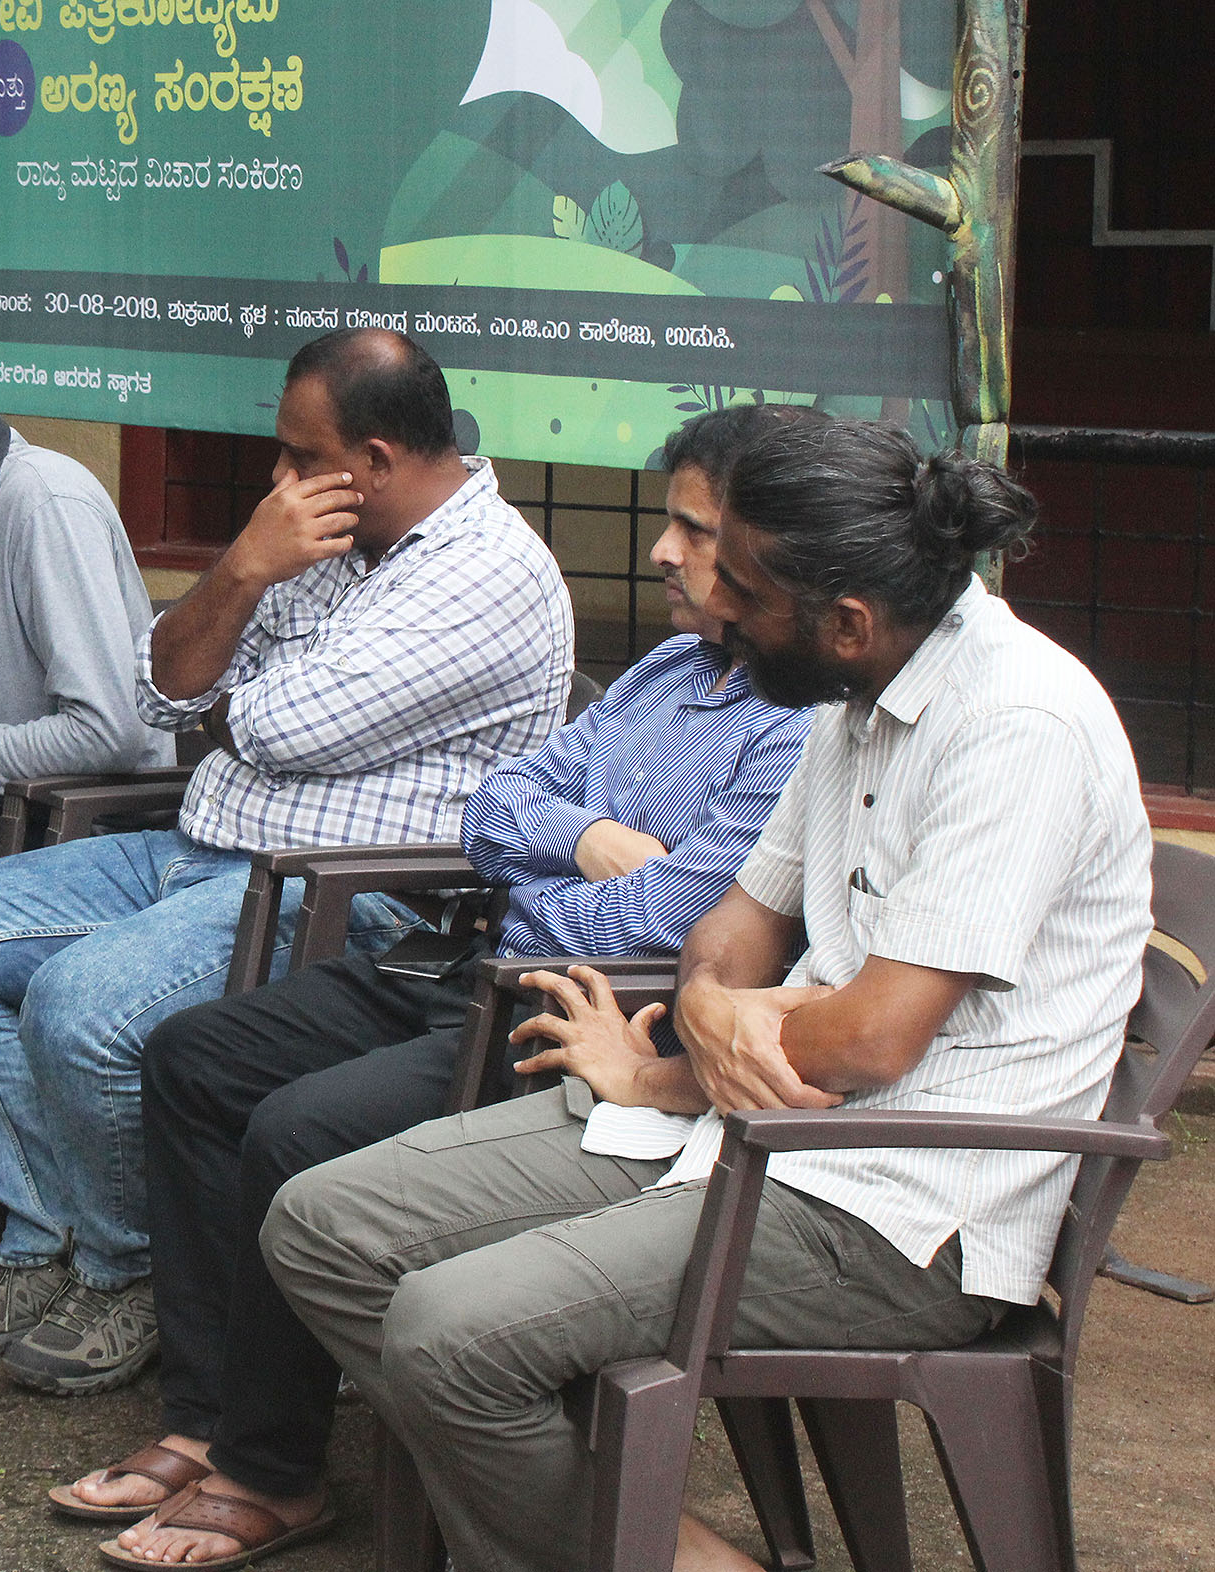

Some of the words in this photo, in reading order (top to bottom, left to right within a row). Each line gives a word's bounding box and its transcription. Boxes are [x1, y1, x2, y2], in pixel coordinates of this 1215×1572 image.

[41, 60, 138, 145] ಅರಣ್ಯ
[154, 55, 304, 137] ಸಂರಕ್ಷಣೆ
[17, 157, 67, 201] ರಾಜ್ಯ
[72, 155, 138, 201] ಮಟ್ಟದ
[144, 156, 211, 188] ವಿಚಾರ
[217, 155, 303, 190] ಸಂಕಿರಣ
[286, 306, 339, 329] ನೂತನ
[107, 371, 152, 402] ಸ್ವಾಗತ
